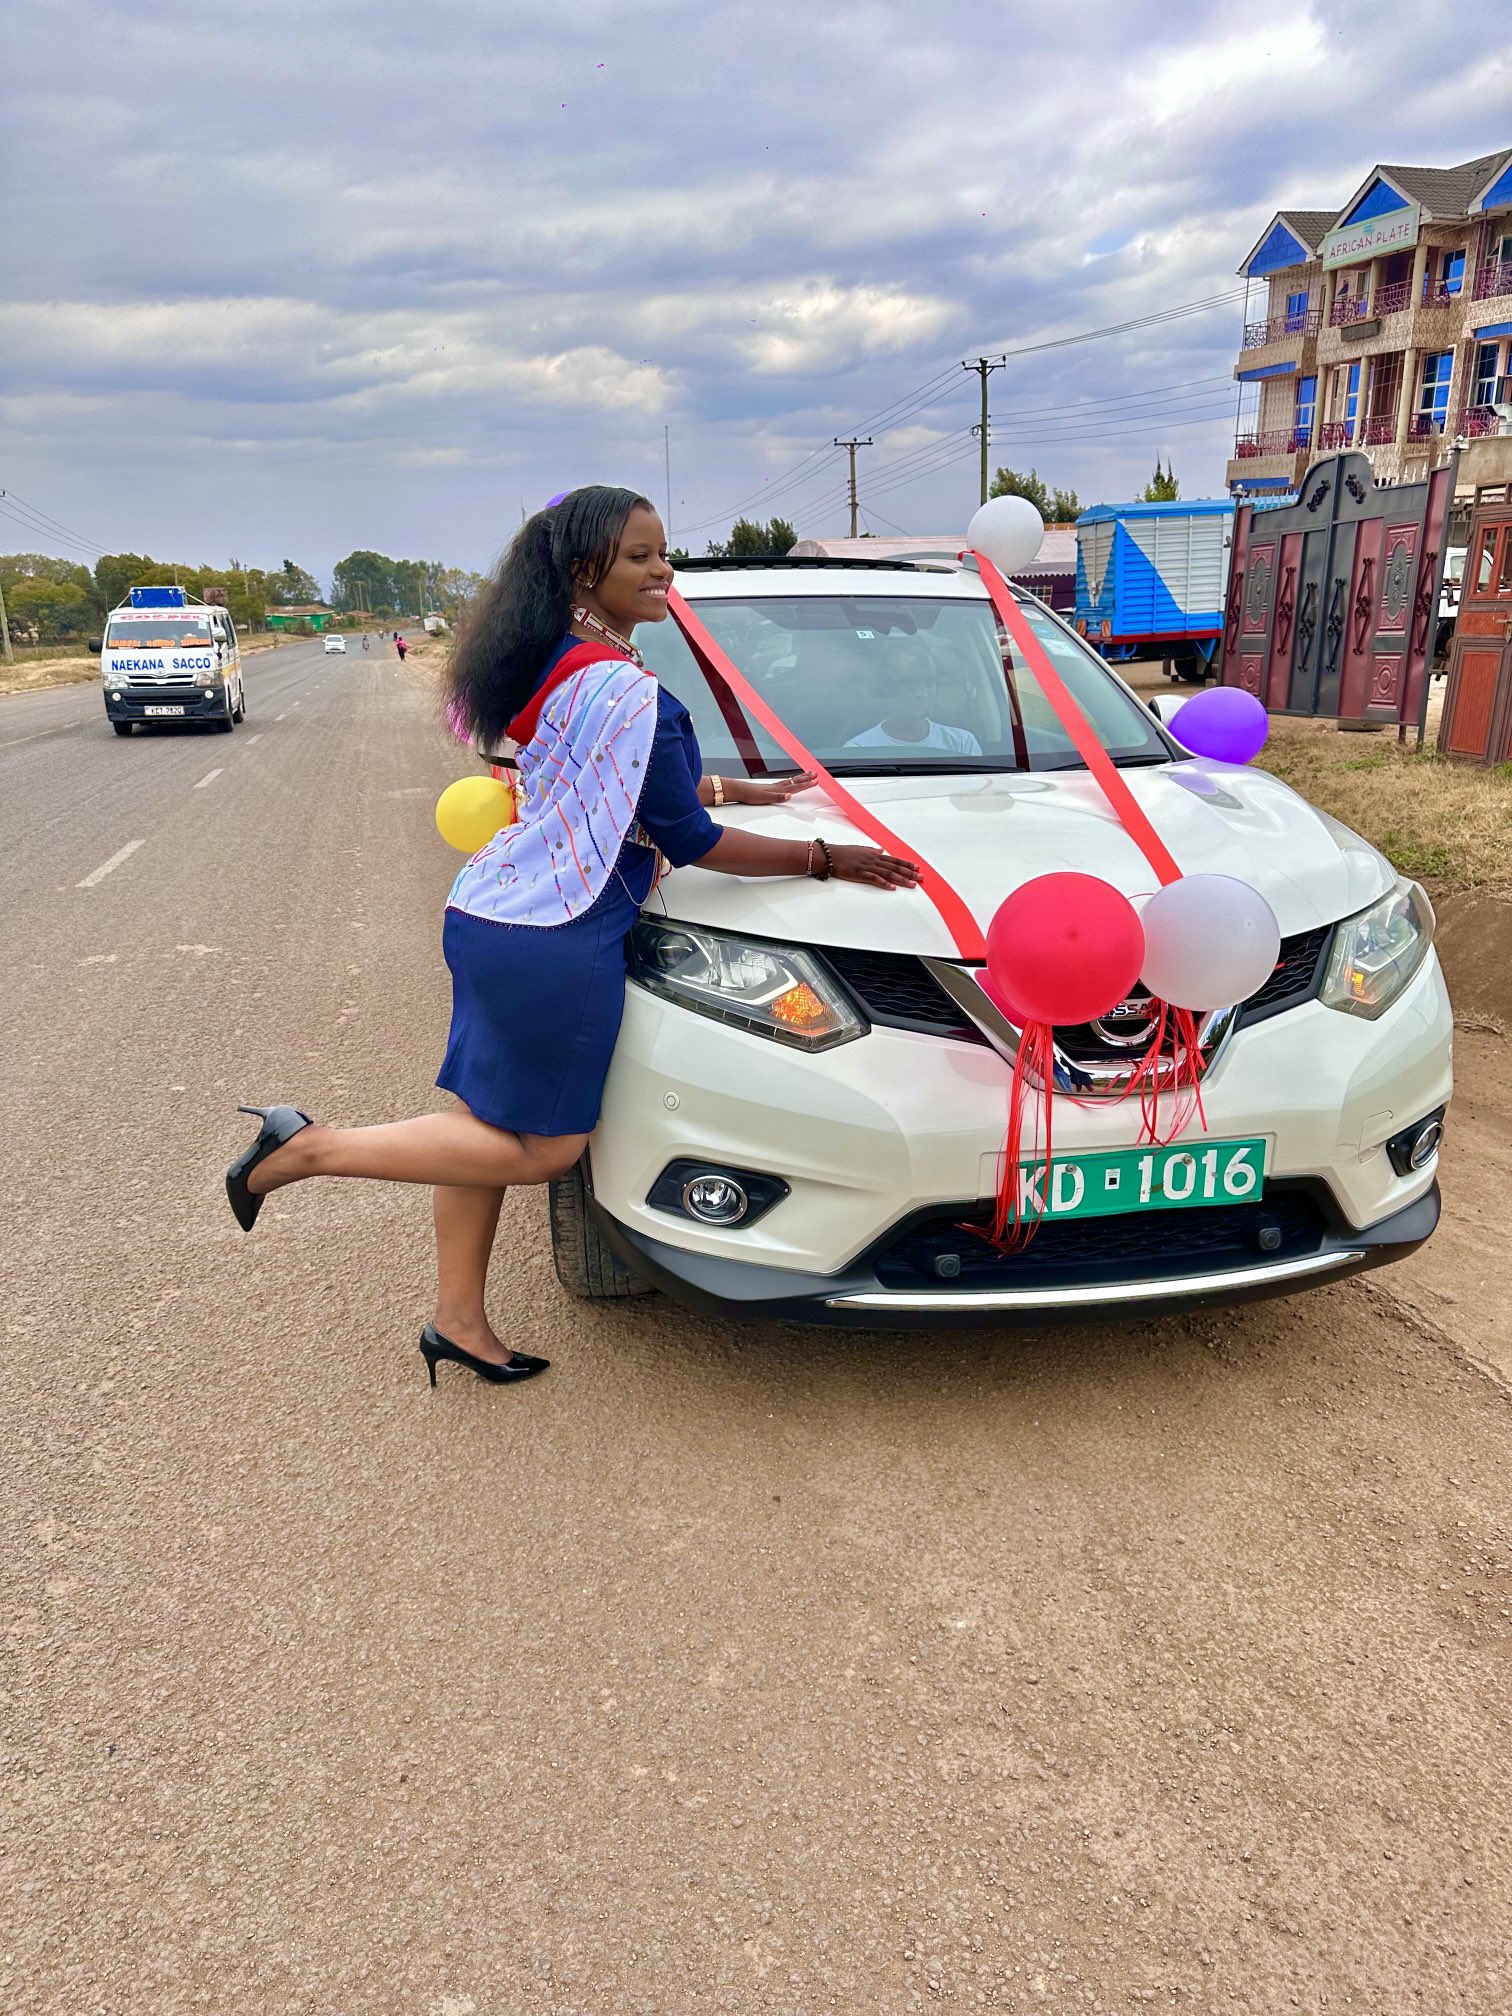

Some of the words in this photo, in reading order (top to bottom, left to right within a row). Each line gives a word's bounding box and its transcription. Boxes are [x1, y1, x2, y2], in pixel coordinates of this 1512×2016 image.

[1329, 234, 1373, 259] AFRICAN
[1376, 223, 1410, 244] PLATE
[111, 659, 164, 671] NAEKANA
[173, 658, 211, 669] SACCO
[1018, 1165, 1085, 1216] KD
[1138, 1148, 1257, 1203] 1016
